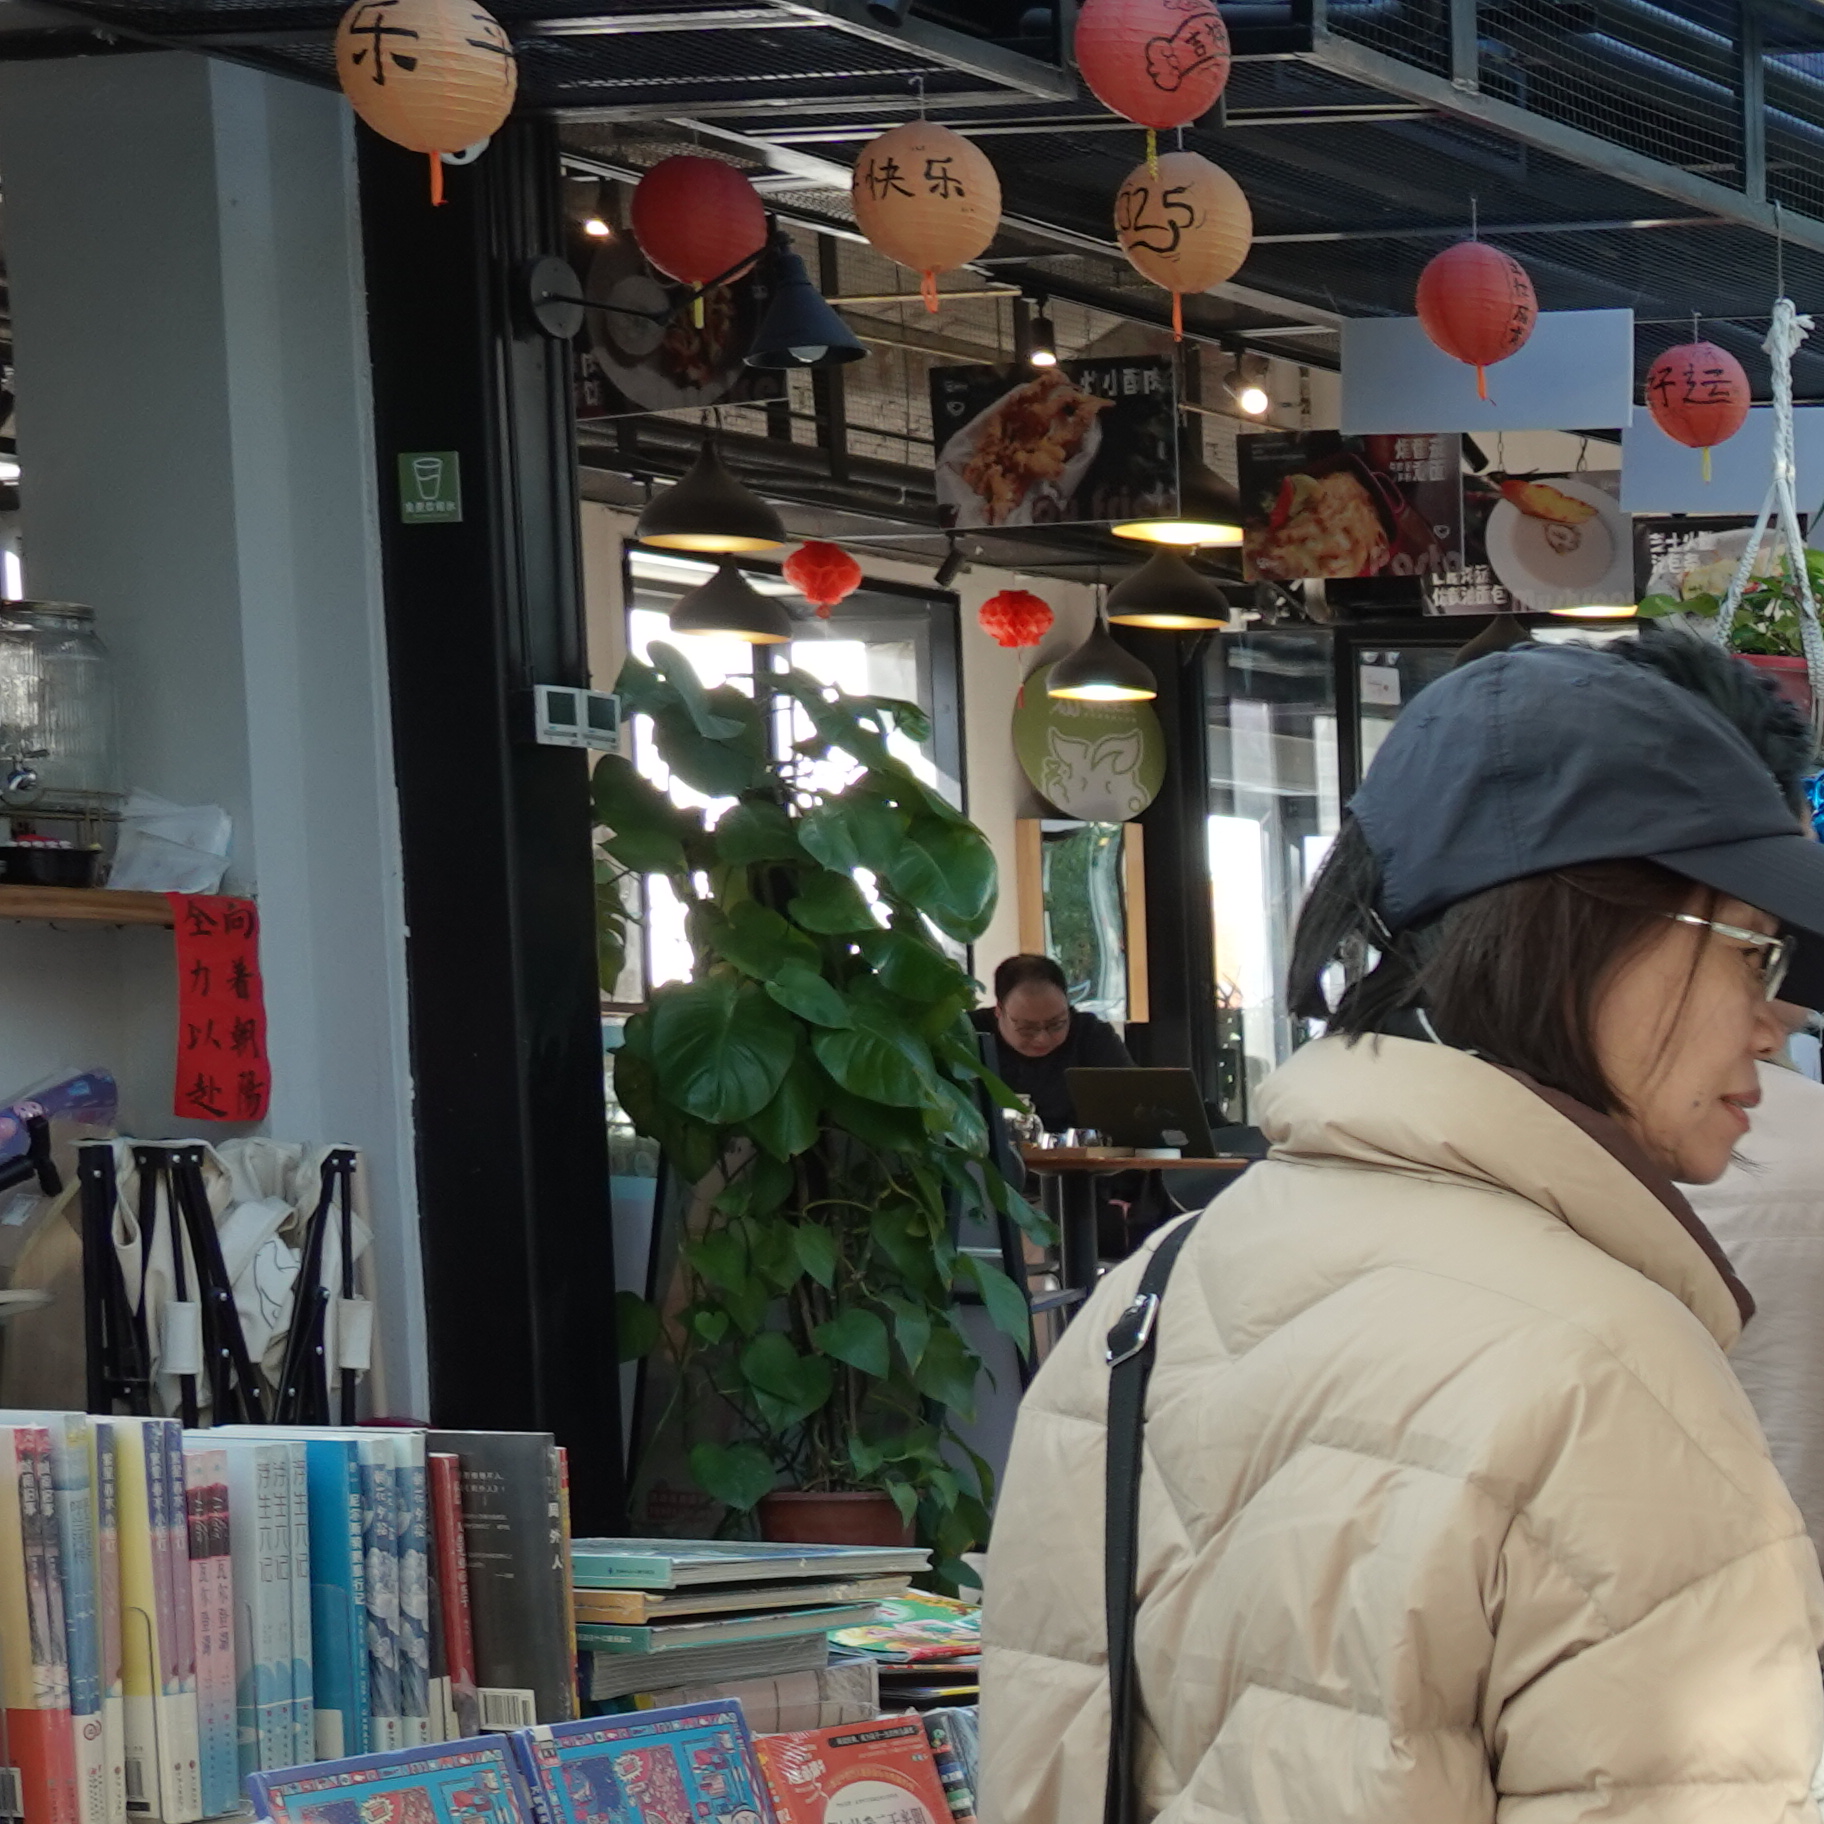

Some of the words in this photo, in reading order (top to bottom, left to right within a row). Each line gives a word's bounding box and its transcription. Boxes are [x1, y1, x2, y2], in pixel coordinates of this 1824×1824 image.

[852, 156, 966, 200] 快乐
[184, 901, 229, 1118] 全力以赴
[256, 1462, 273, 1583] 浮生六记
[273, 1460, 289, 1580] 浮生六记
[292, 1459, 309, 1578] 浮生六记
[547, 1502, 564, 1571] 局外人
